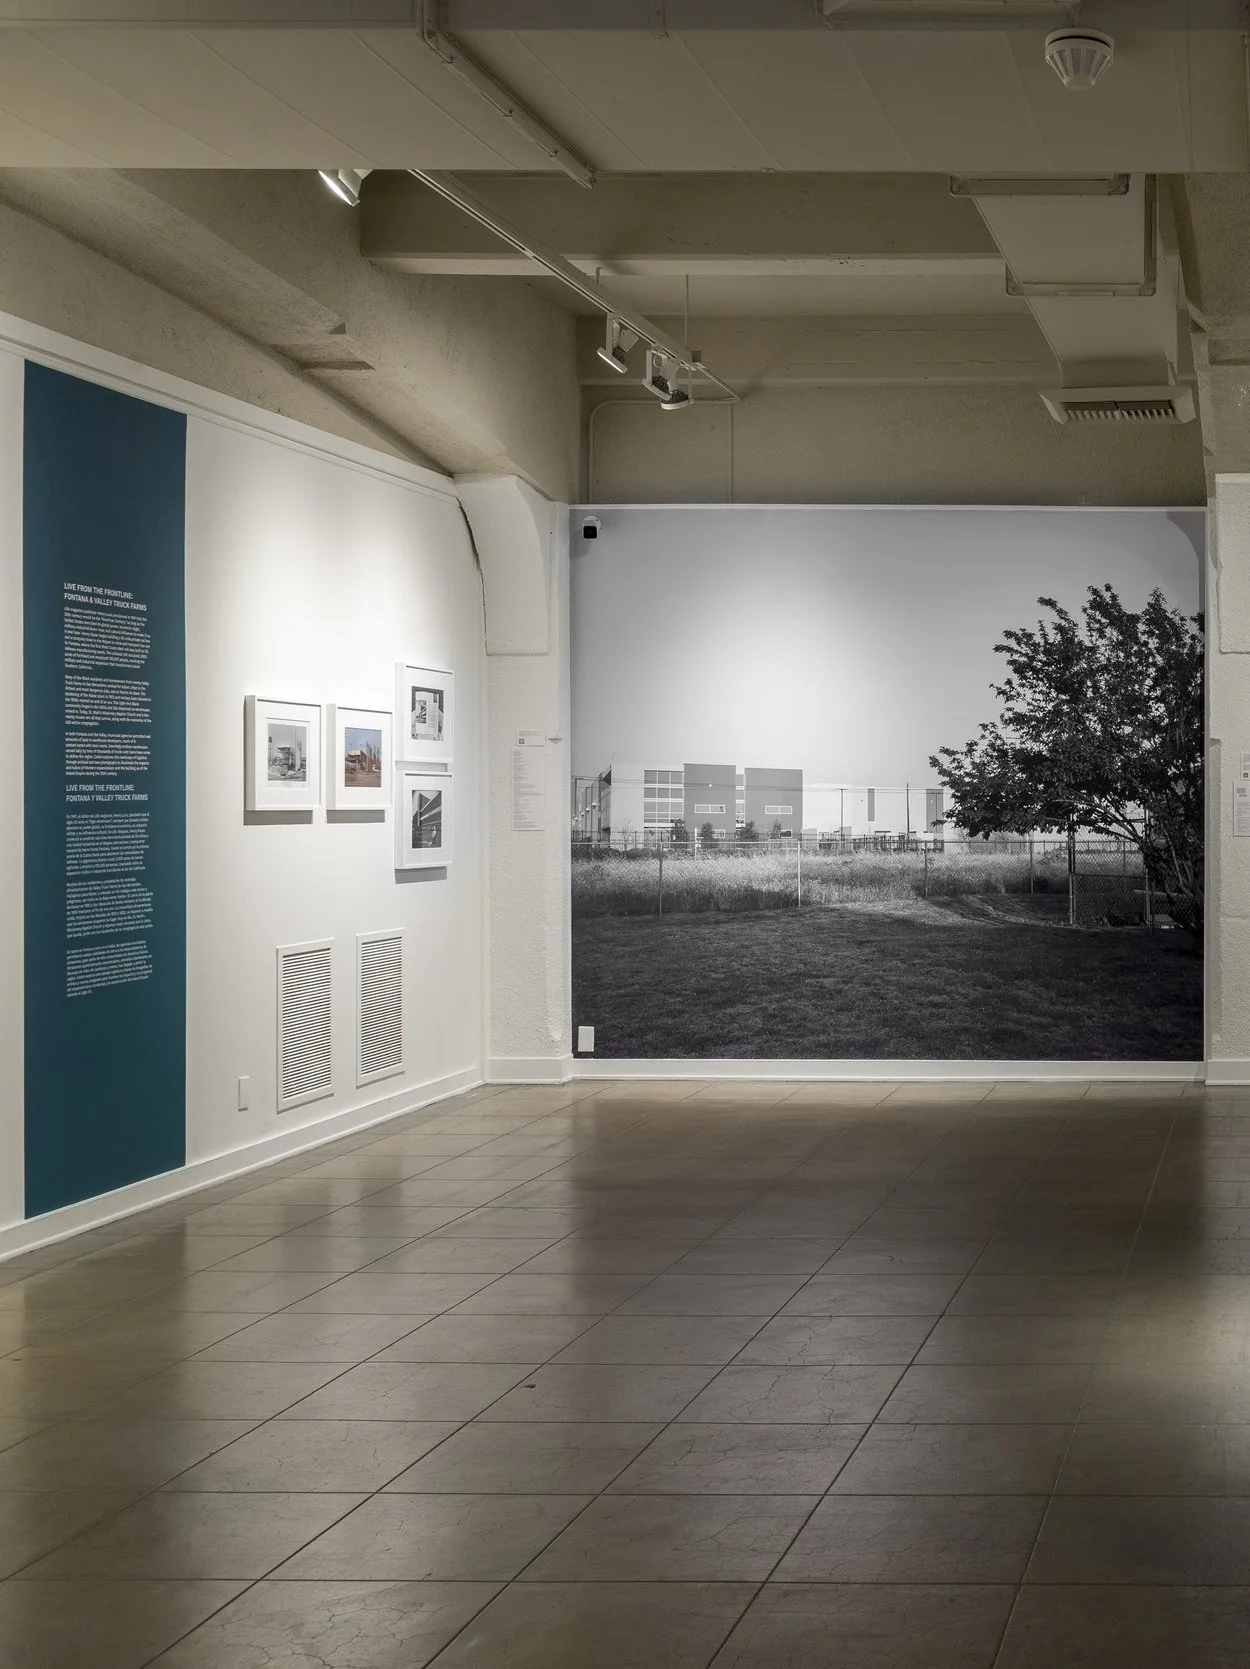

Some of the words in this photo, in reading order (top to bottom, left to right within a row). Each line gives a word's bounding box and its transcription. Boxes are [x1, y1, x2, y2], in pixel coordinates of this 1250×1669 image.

[64, 582, 76, 590] LIVE
[77, 584, 92, 593] FROM
[64, 593, 88, 603] FONTANA
[94, 597, 112, 606] VALLEY
[114, 600, 130, 609] TRUCK
[131, 603, 147, 611] FARMS
[66, 794, 90, 802] FONTANA
[132, 793, 148, 801] FARMS
